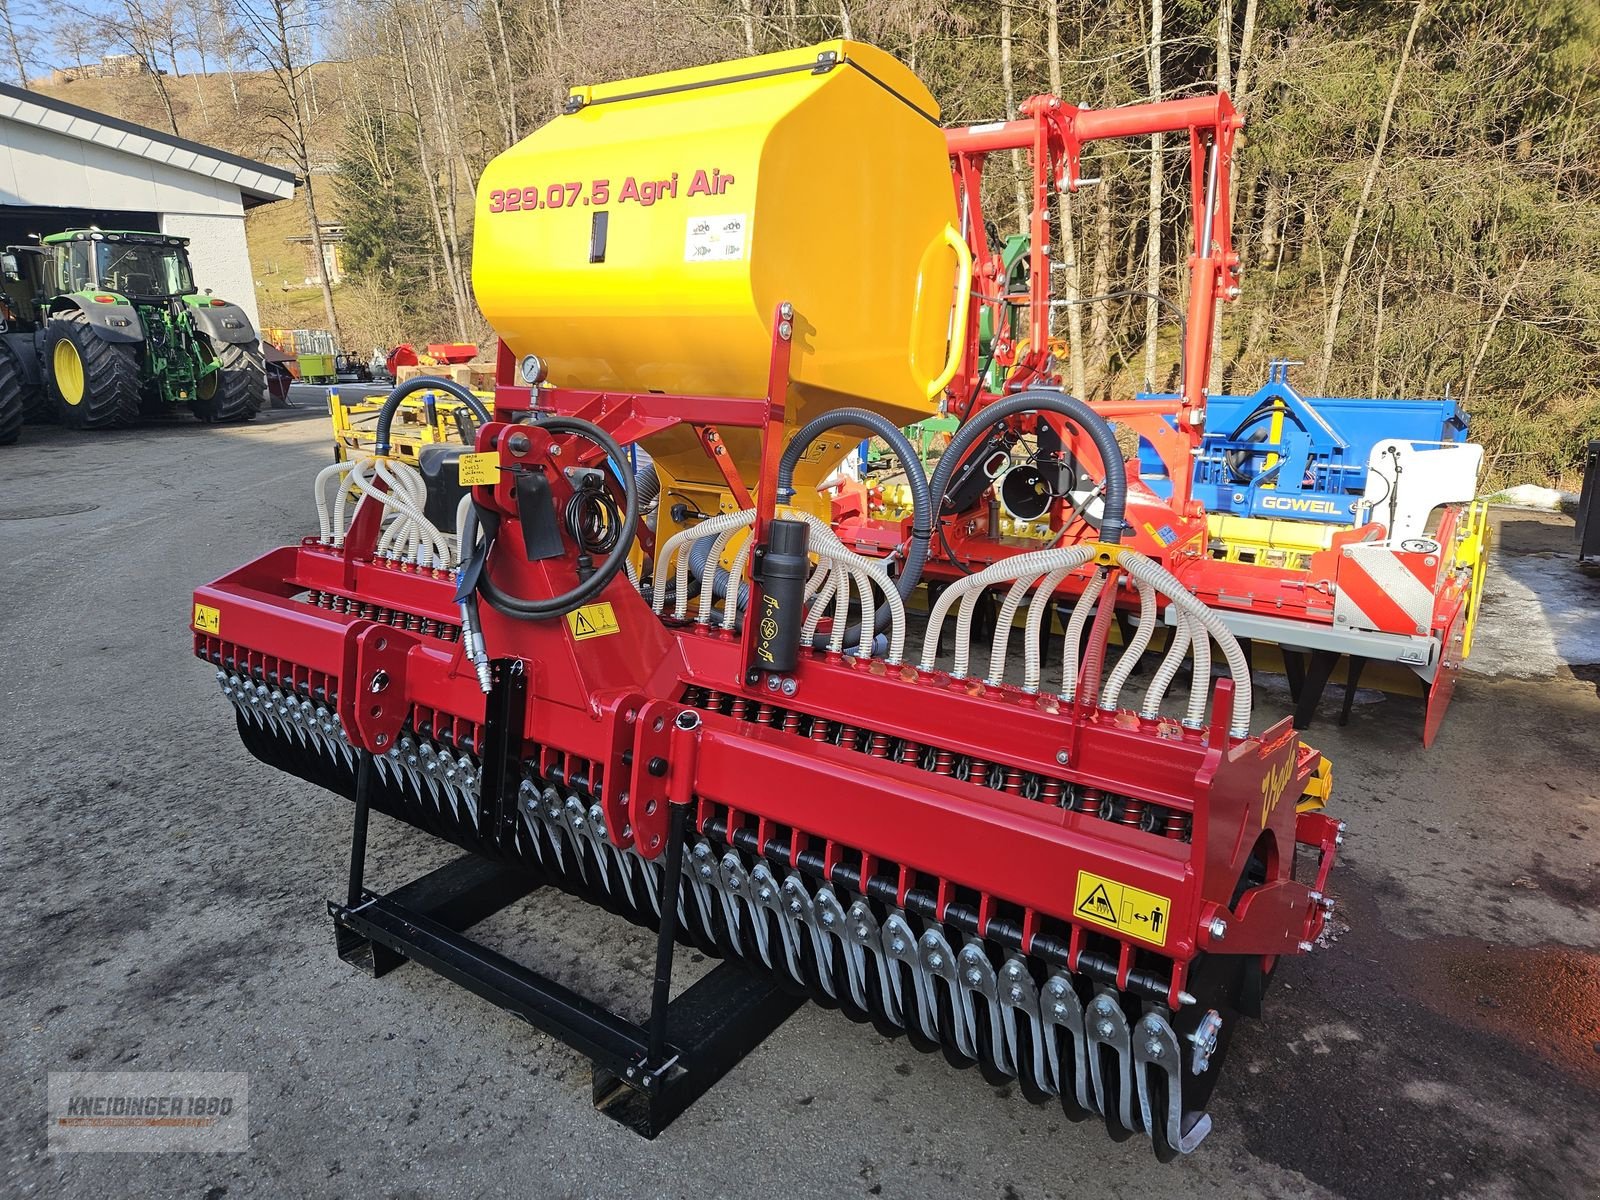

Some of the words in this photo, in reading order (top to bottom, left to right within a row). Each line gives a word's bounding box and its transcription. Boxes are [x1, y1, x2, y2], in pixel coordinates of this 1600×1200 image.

[489, 179, 610, 213] 329.07.5
[618, 172, 678, 206] Agri
[687, 168, 735, 197] Air
